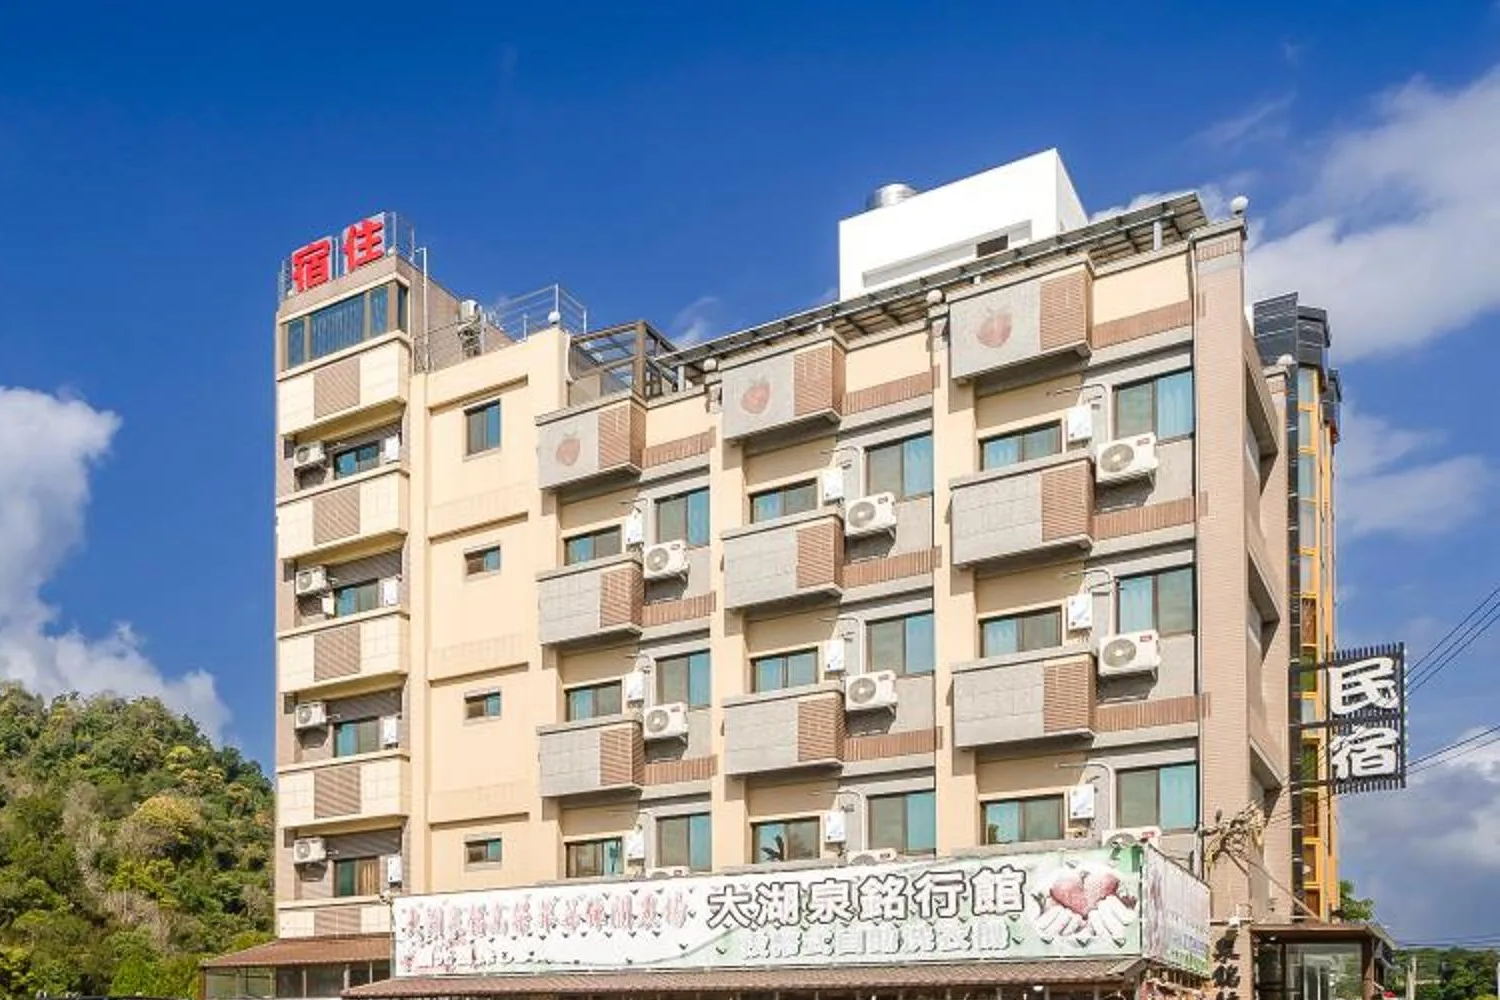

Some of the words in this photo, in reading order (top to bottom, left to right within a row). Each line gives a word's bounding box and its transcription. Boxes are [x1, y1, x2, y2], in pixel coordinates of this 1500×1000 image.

[1329, 656, 1400, 780] 民宿
[707, 865, 1026, 929] 大湖泉銘行館
